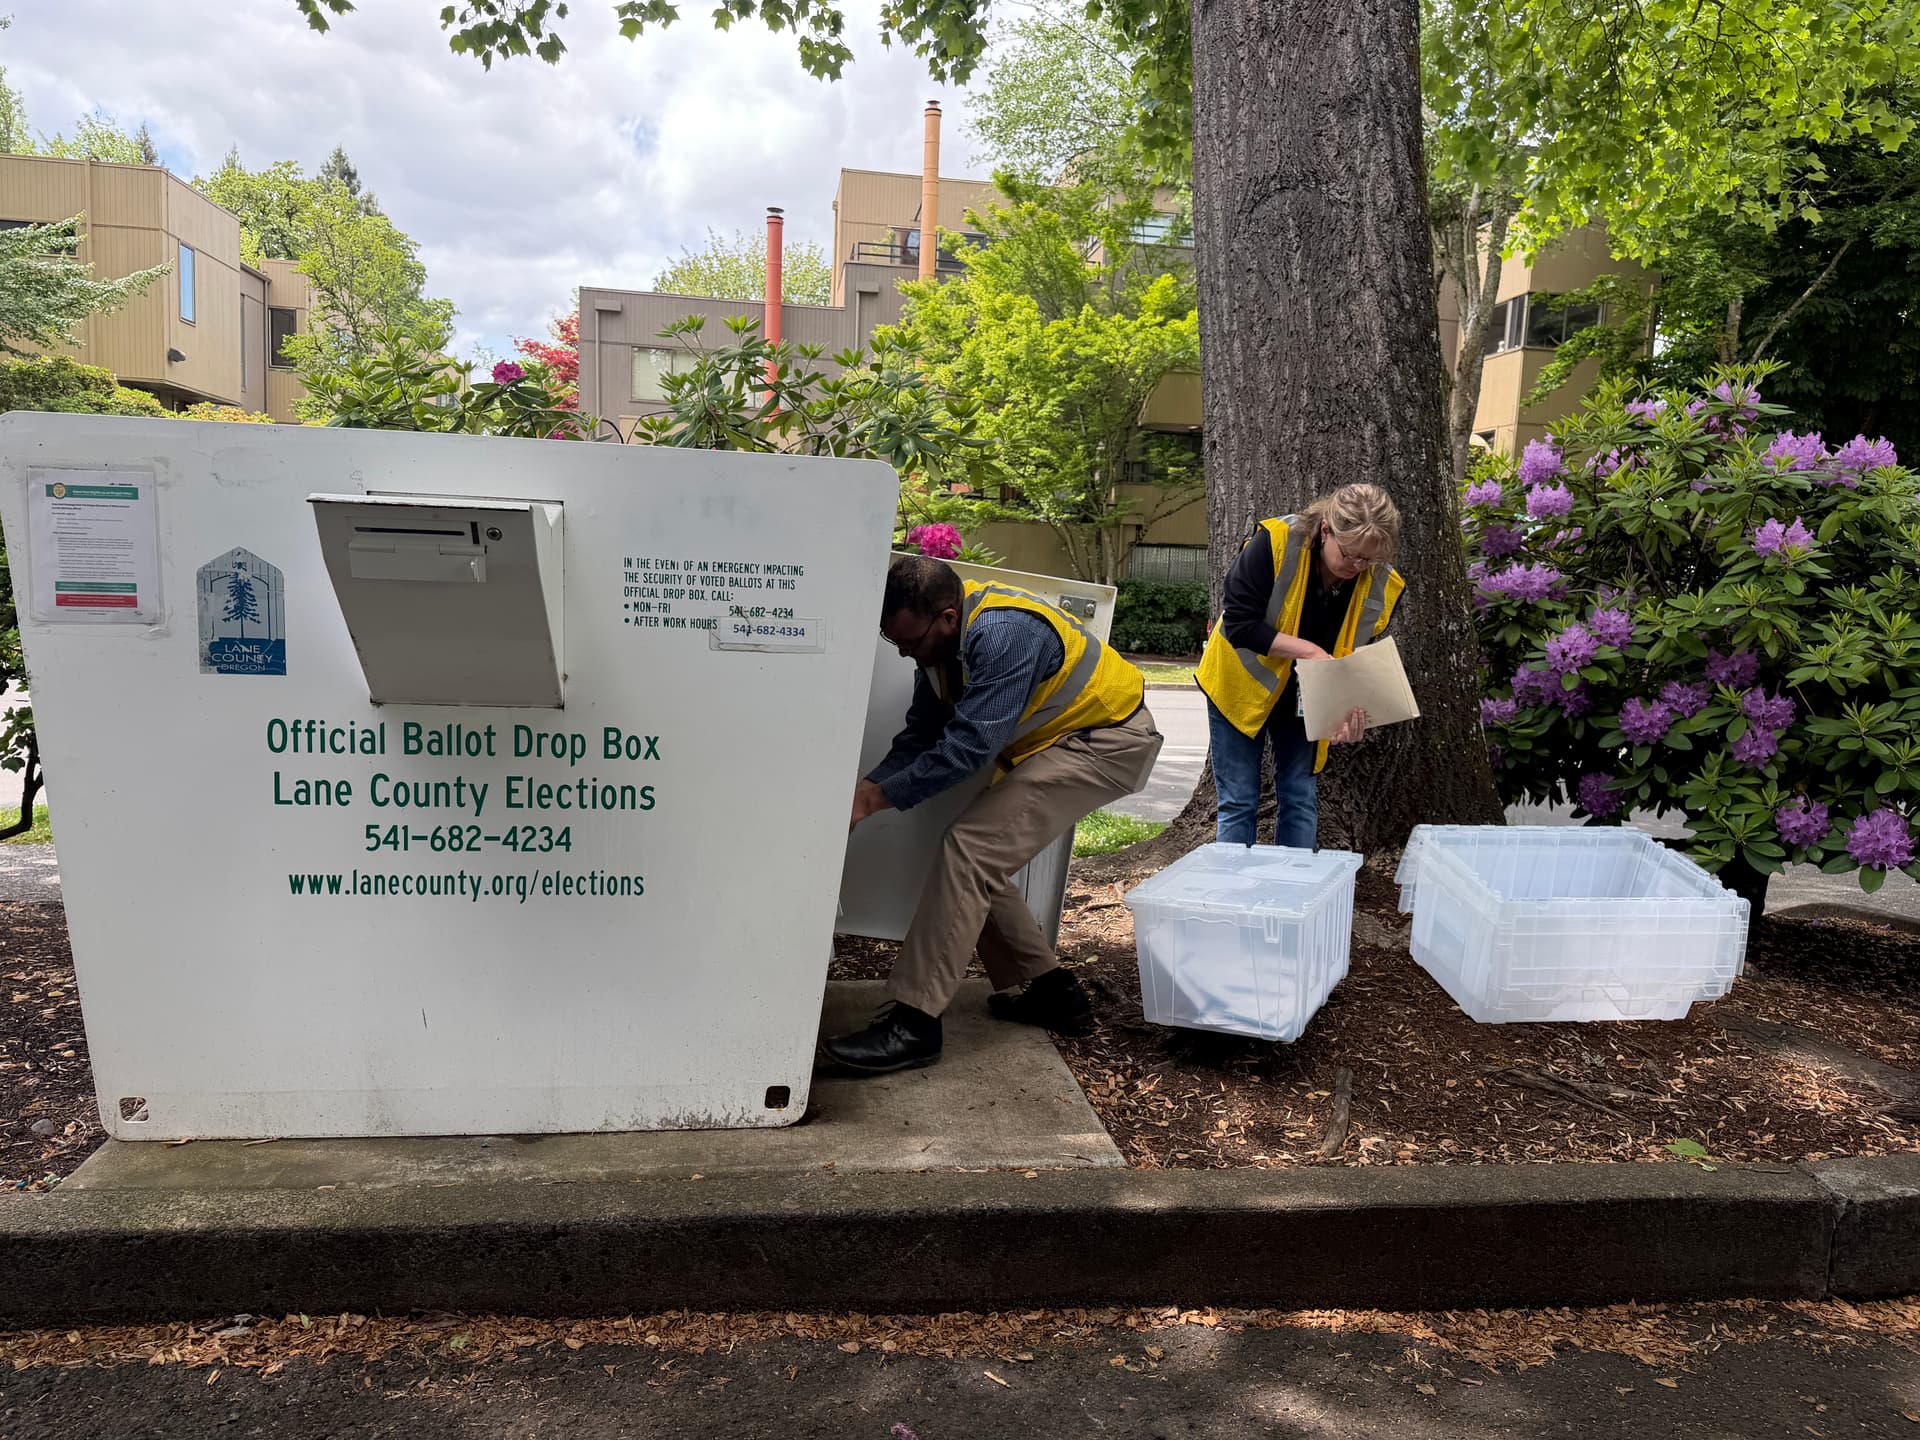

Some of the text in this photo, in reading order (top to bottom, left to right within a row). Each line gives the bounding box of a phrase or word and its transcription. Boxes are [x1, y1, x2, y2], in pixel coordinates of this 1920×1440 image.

[624, 557, 632, 569] IN
[636, 558, 651, 569] THE
[683, 560, 694, 571] OF
[697, 561, 709, 572] AN
[712, 561, 760, 575] EMERGENCY
[763, 564, 804, 577] IMPACTING
[624, 572, 796, 590] THE SECURITY OF VOTED BALLOTS AT THIS
[624, 586, 660, 599] OFFICIAL
[663, 588, 686, 600] DROP
[711, 590, 734, 602] CALL:
[633, 601, 794, 619] MON-FRI 541-682-4234
[634, 616, 718, 631] AFTER WORK HOURS
[733, 624, 805, 637] 541-682-4334
[225, 644, 261, 654] LANE
[211, 653, 273, 664] COUNTY
[220, 663, 266, 671] OREGON
[266, 718, 661, 767] Official Ballot Drop Box
[273, 771, 656, 817] Lane County Elections
[364, 824, 572, 853] 541-682-4234
[288, 869, 645, 904] www.lanecounty.org/elections
